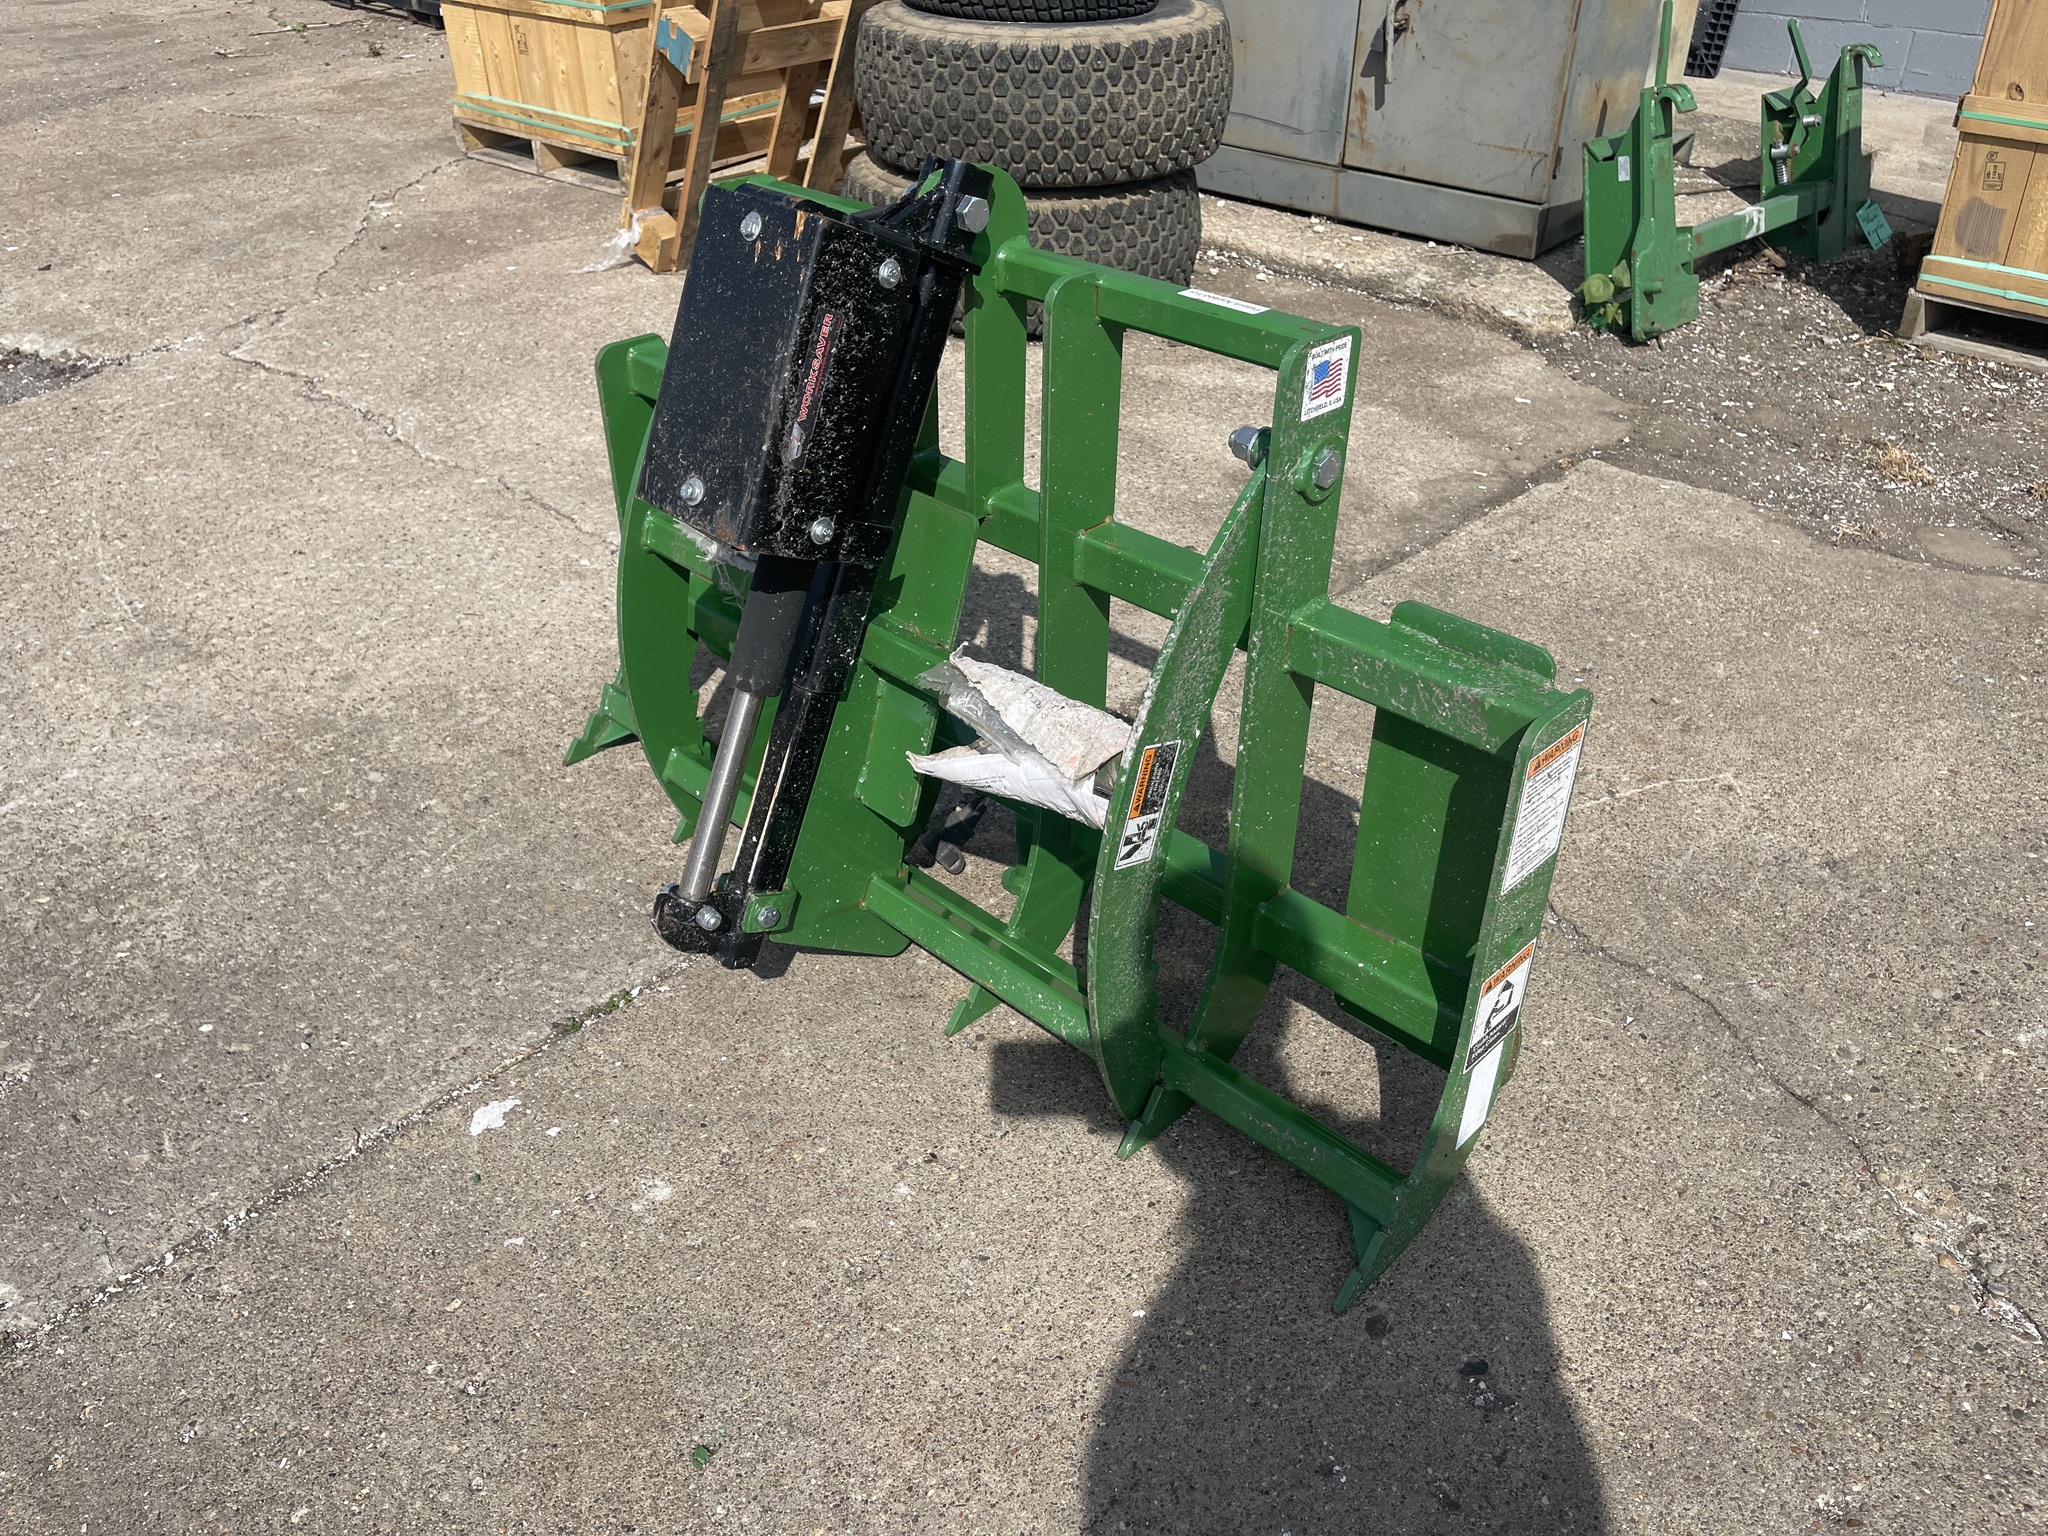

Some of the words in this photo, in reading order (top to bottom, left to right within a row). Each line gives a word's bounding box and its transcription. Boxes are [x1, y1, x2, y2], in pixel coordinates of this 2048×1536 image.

[797, 313, 834, 422] WORKSAVER
[1335, 341, 1348, 352] PRIDE
[1541, 731, 1579, 766] WARNING
[1134, 754, 1153, 804] WARNING
